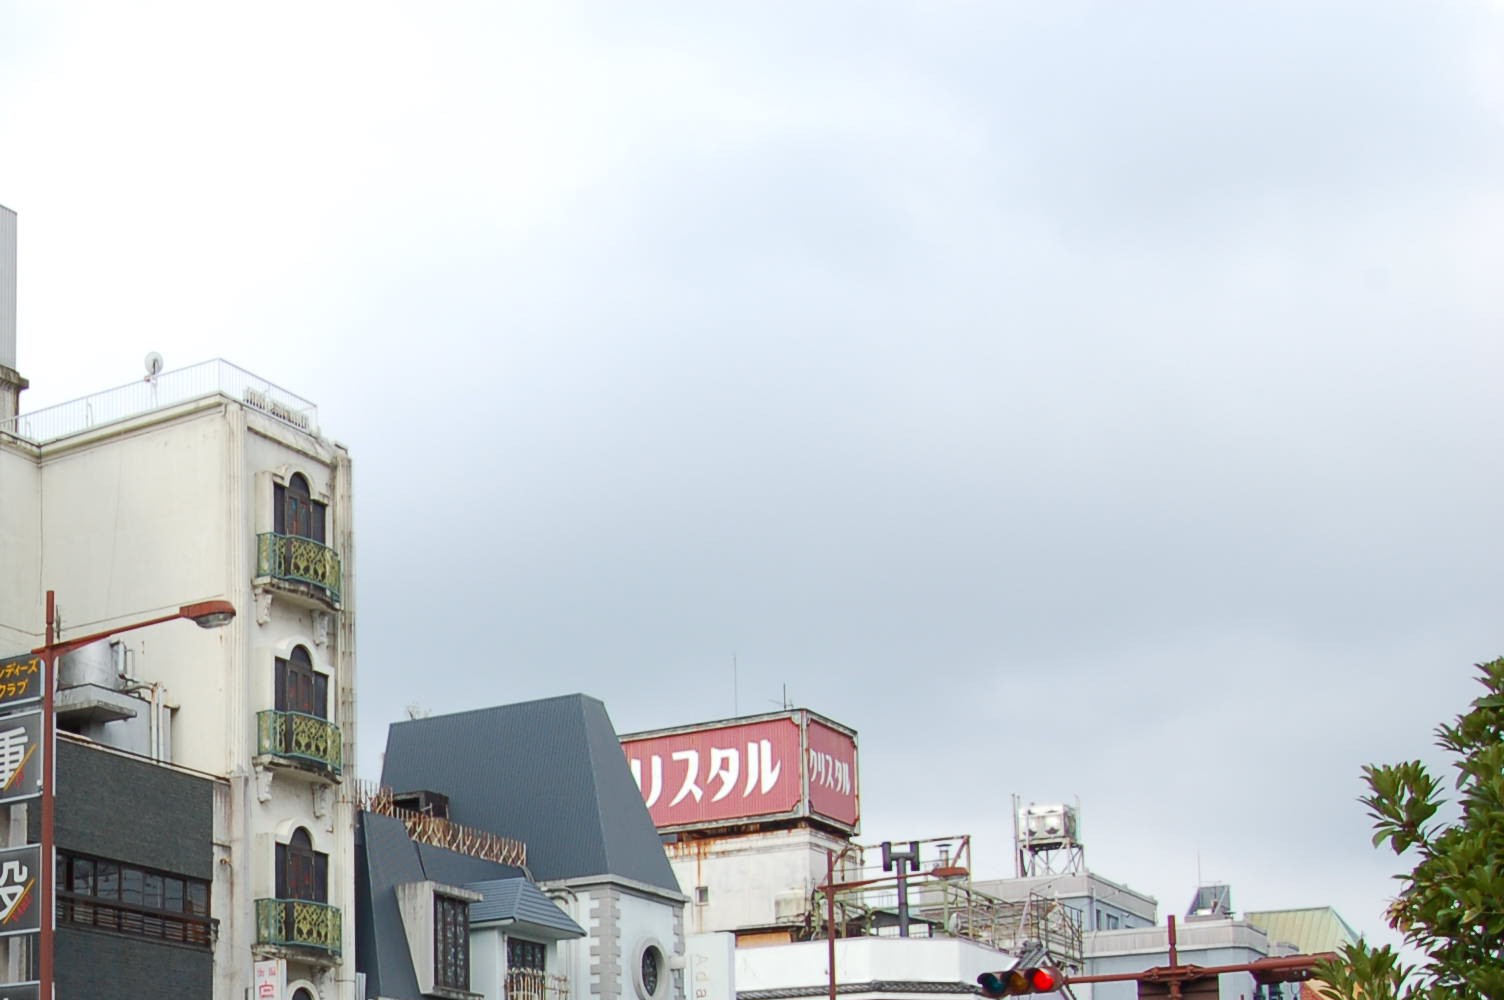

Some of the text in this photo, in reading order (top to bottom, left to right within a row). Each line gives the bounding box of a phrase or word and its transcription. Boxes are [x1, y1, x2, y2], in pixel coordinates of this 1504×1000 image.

[630, 739, 782, 809] リスタル
[809, 748, 851, 797] クリスタル
